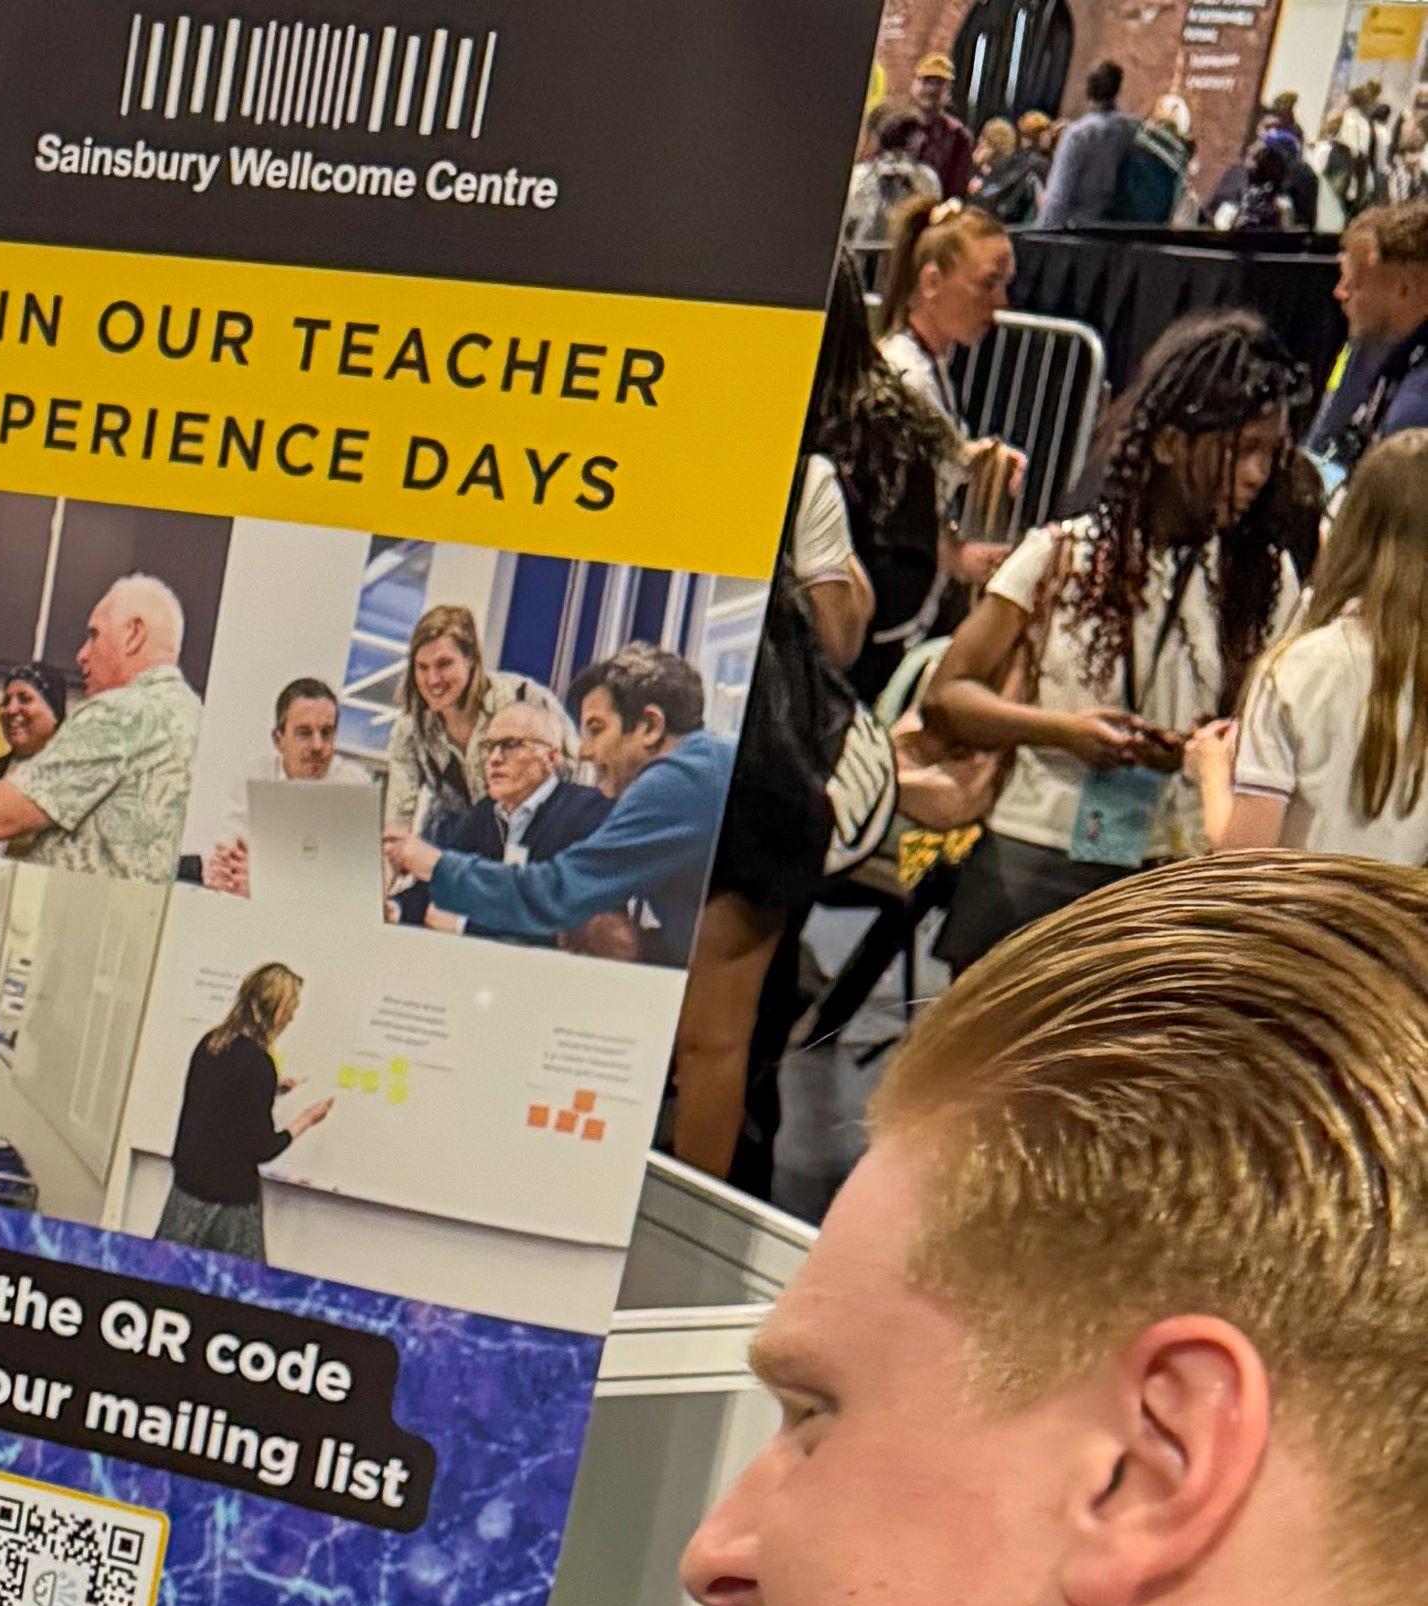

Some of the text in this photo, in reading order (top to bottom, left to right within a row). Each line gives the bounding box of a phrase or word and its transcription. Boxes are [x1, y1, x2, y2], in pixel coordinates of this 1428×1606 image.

[33, 131, 559, 211] Sainsbury Wellcome Centre
[96, 299, 256, 366] OUR
[292, 314, 668, 407] TEACHER
[404, 434, 620, 513] DAYS
[99, 1299, 191, 1367] QR
[205, 1323, 353, 1405] code
[86, 1384, 300, 1490] mailing
[316, 1437, 410, 1510] list
